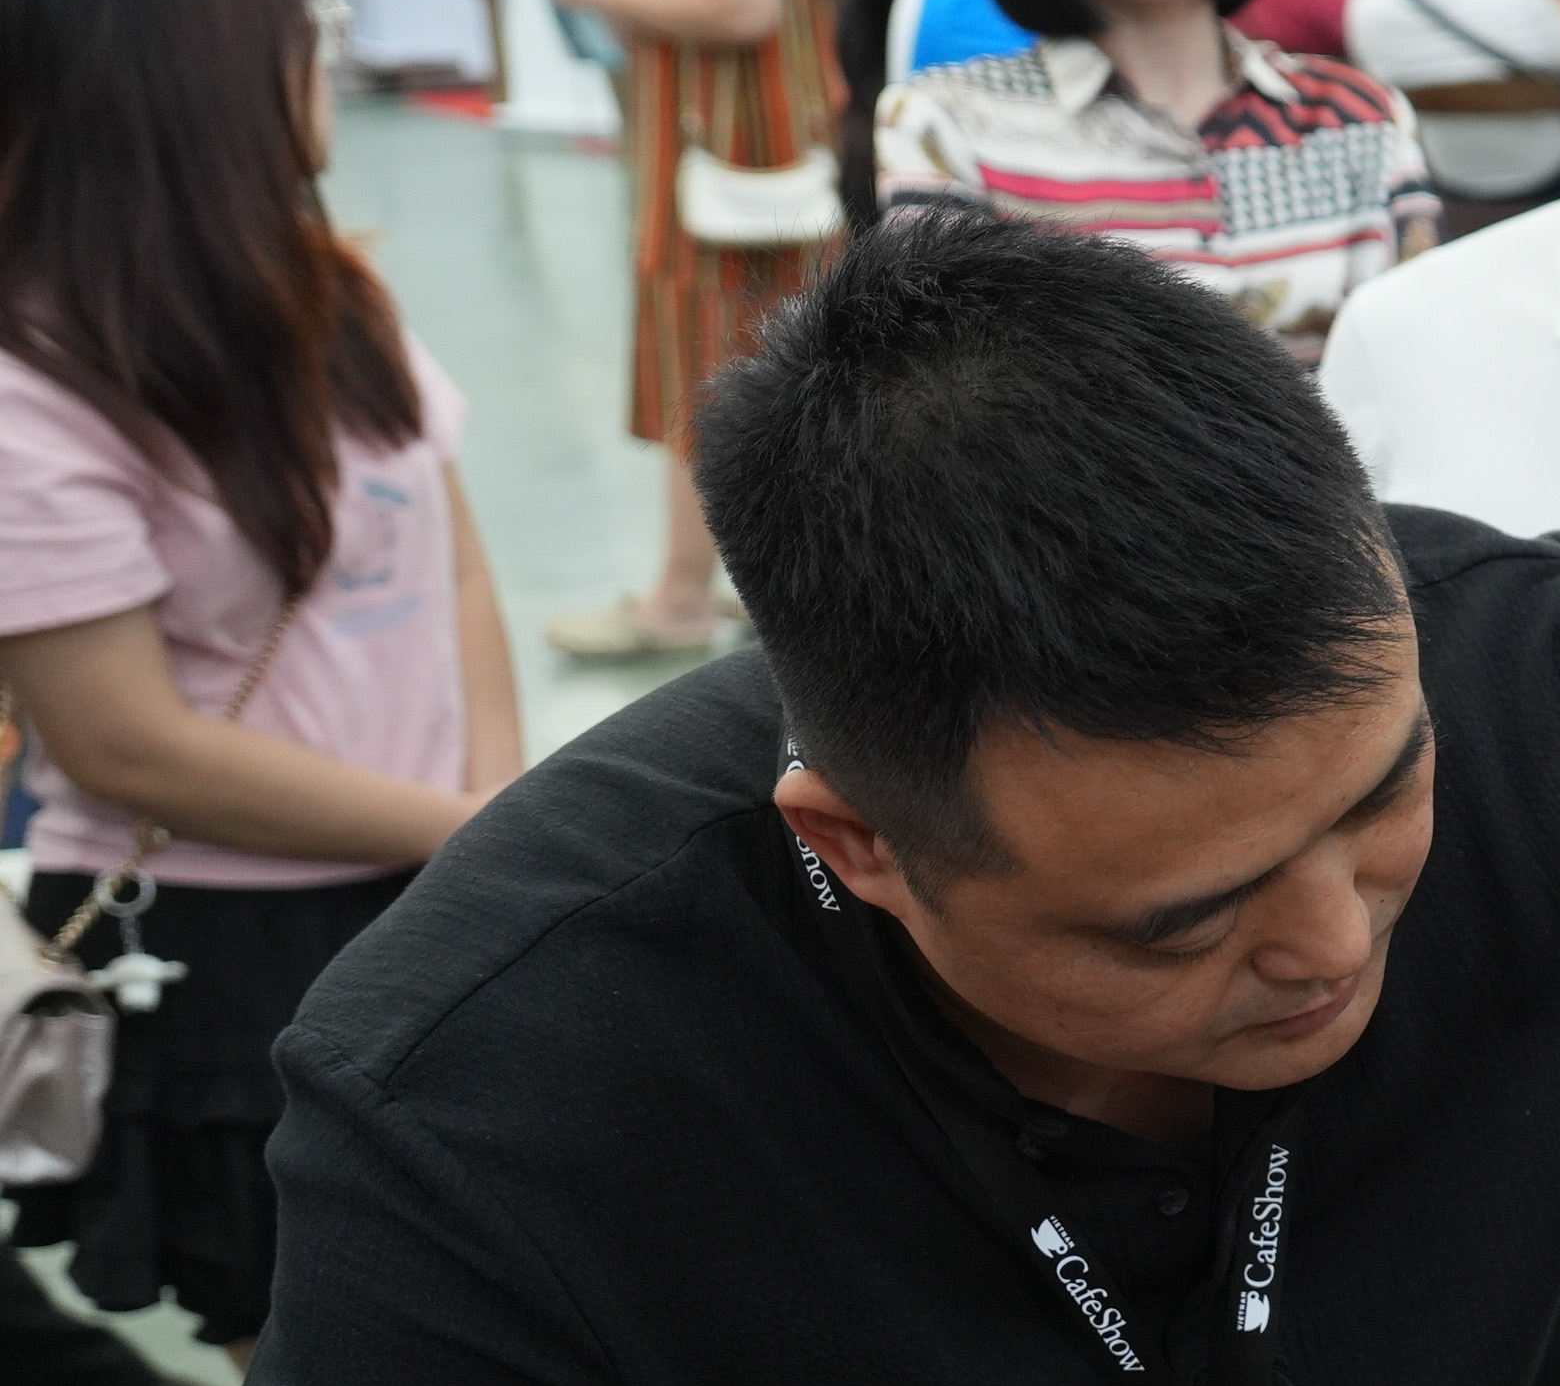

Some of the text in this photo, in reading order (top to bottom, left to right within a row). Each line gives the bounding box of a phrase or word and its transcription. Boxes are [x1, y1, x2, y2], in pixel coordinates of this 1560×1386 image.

[1050, 1215, 1075, 1249] VIETNAM
[1244, 1144, 1290, 1288] CafeShow
[1056, 1255, 1145, 1371] CafeShow
